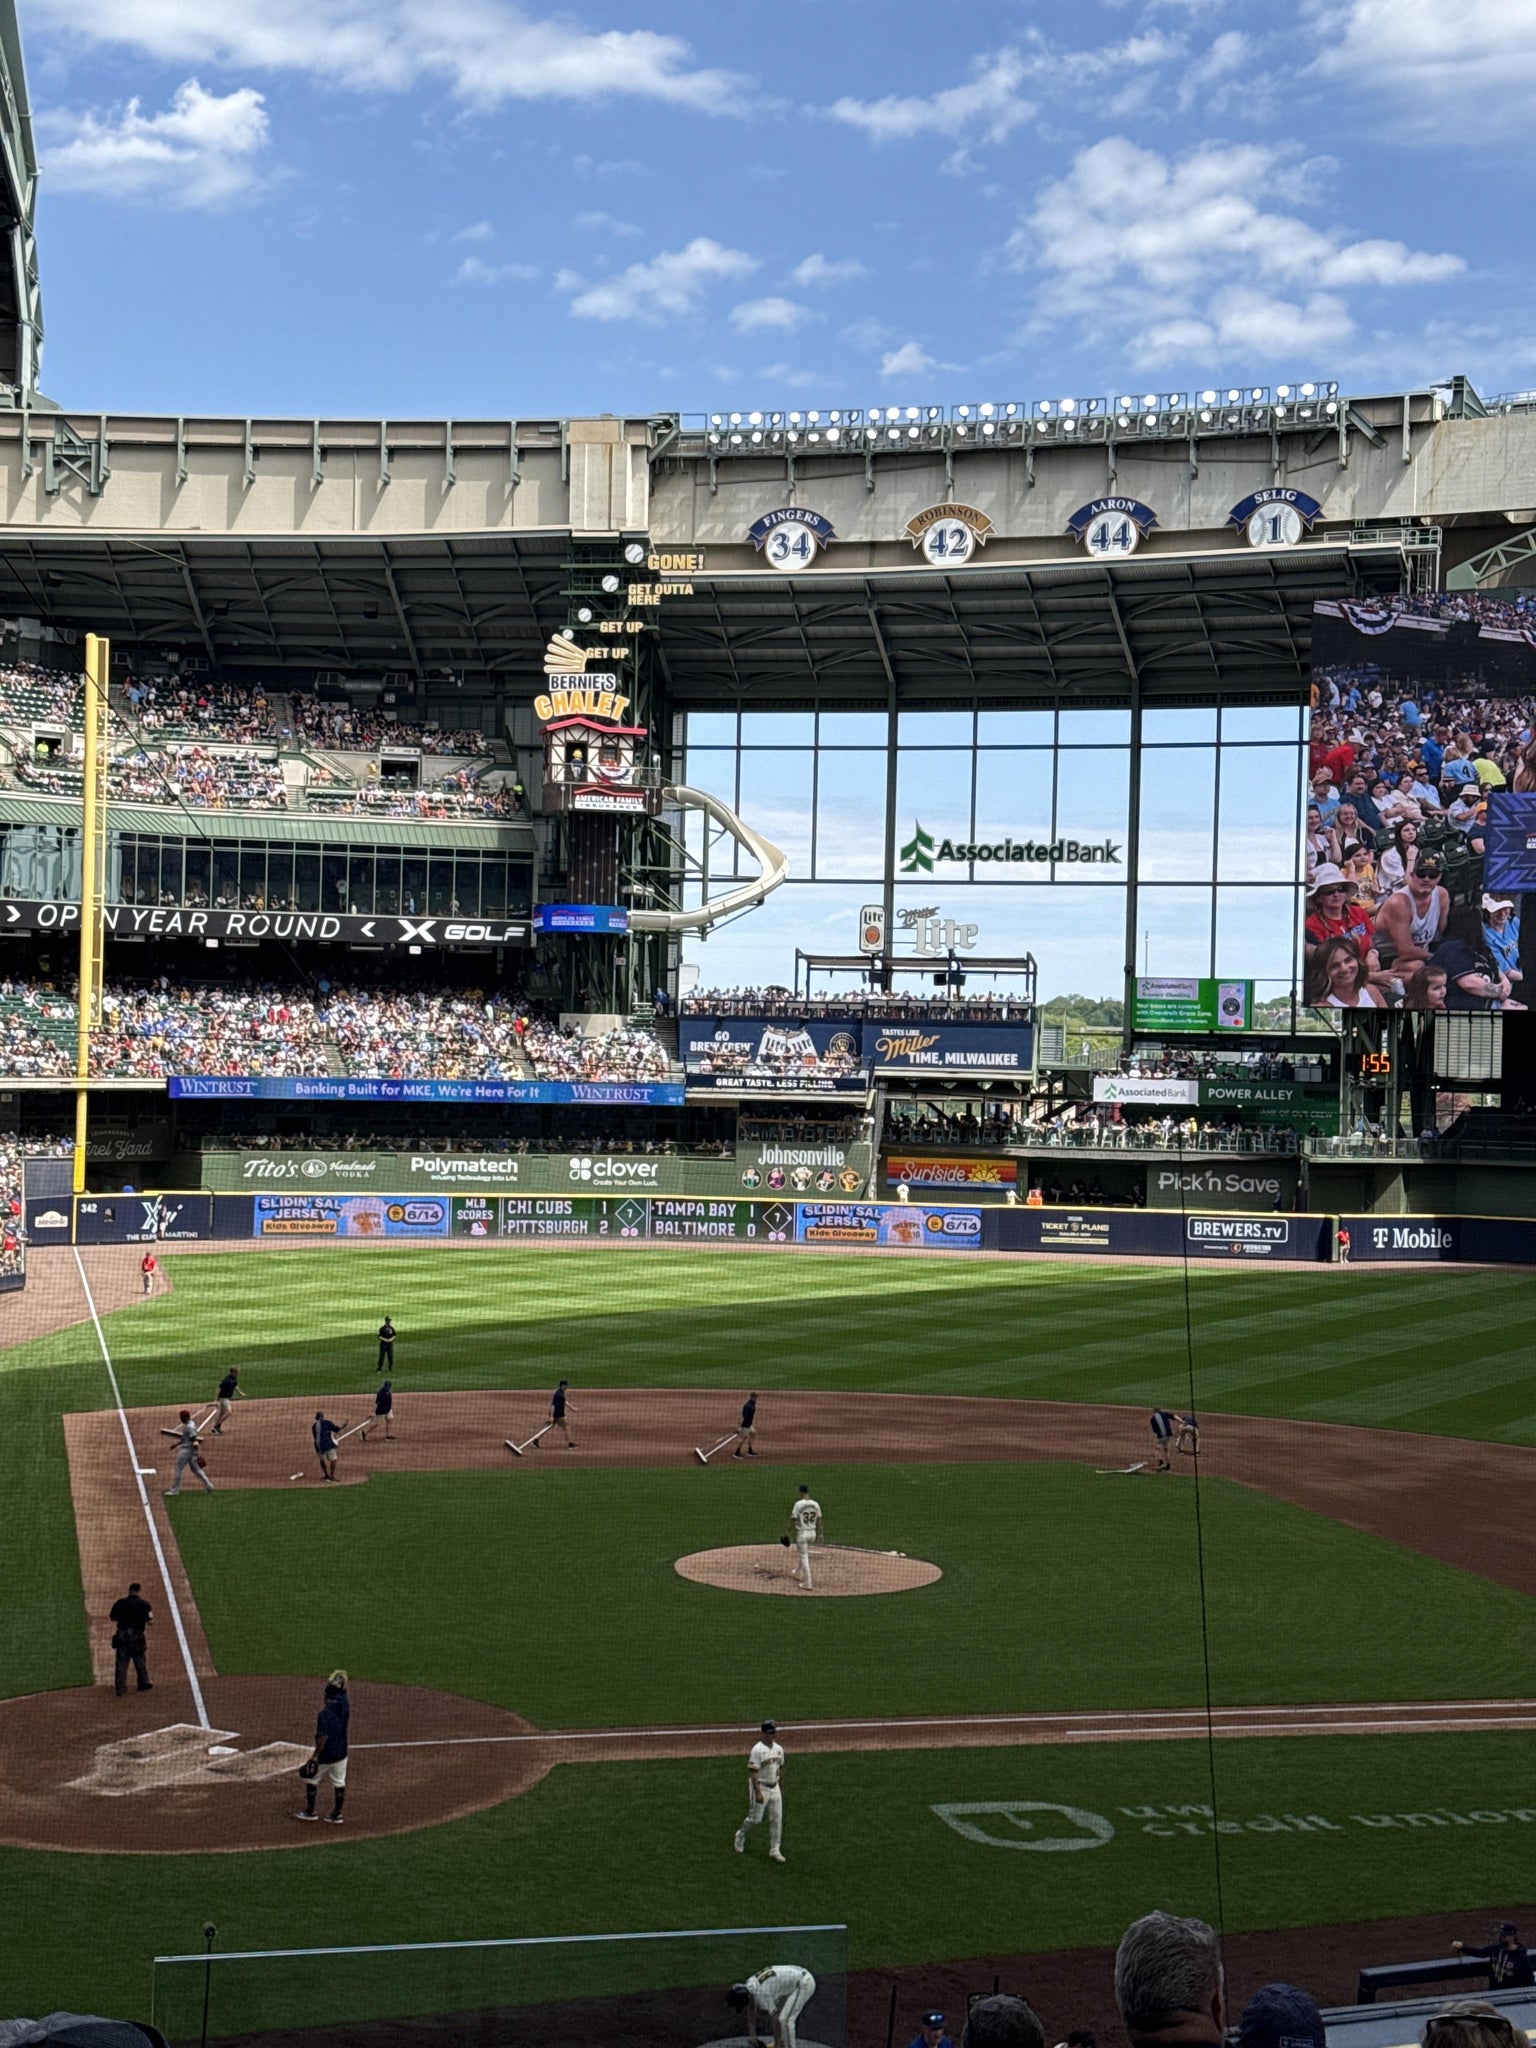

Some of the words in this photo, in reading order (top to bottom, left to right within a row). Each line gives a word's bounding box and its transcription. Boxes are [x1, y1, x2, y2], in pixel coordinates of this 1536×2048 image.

[1253, 489, 1298, 505] SELIG
[1090, 499, 1137, 515] AARON
[762, 509, 821, 528] FINGERS
[916, 505, 982, 527] ROBINSON
[1090, 519, 1133, 552] 44
[1266, 513, 1285, 545] 1
[771, 532, 812, 561] 34
[928, 527, 969, 558] 42
[647, 554, 705, 570] GONE!
[627, 583, 652, 596] GET
[655, 583, 695, 596] OUTTA
[627, 594, 661, 606] HERE
[599, 621, 624, 634] GET
[626, 621, 645, 634] UP
[586, 647, 610, 660] GET
[612, 647, 630, 660] UP
[550, 674, 616, 691] BERNIE'S
[533, 691, 631, 721] CHALET
[575, 794, 615, 804] AMERICAN
[616, 796, 644, 805] FAMILY
[37, 904, 120, 931] OPN
[131, 909, 209, 935] YEAR
[225, 913, 341, 940] ROUND
[443, 923, 527, 942] GOLF
[863, 911, 884, 925] Lite
[911, 917, 980, 958] Lite
[714, 1030, 730, 1042] GO
[881, 1028, 905, 1036] TASTES
[905, 1029, 921, 1037] LIKE
[690, 1040, 720, 1052] BREW
[721, 1042, 751, 1053] CREW
[875, 1034, 941, 1063] Miller
[908, 1051, 943, 1066] TIME,
[944, 1052, 1018, 1066] MILWAUKEE
[1360, 1053, 1390, 1073] 1:55
[295, 1081, 346, 1098] Banking
[348, 1082, 378, 1096] Built
[380, 1082, 400, 1096] for
[402, 1083, 436, 1098] MKE,
[438, 1084, 473, 1097] We're
[475, 1085, 505, 1098] Here
[507, 1086, 527, 1098] For
[529, 1086, 540, 1098] It
[715, 1077, 744, 1087] GREAT
[745, 1078, 775, 1088] TASTE.
[776, 1080, 797, 1089] LESS
[1208, 1087, 1252, 1100] POWER
[1254, 1088, 1294, 1101] ALLEY
[758, 1143, 845, 1167] Johnsonville
[243, 1158, 298, 1179] Tito's
[329, 1159, 377, 1171] Handmade
[411, 1156, 519, 1176] Polymatech
[593, 1157, 659, 1178] clover
[899, 1161, 966, 1183] Surfside
[335, 1171, 370, 1179] VODKA
[456, 1174, 491, 1182] Technology
[592, 1179, 613, 1187] Create
[613, 1179, 628, 1187] Your
[1225, 1174, 1280, 1194] Save
[80, 1203, 98, 1214] 342
[260, 1197, 312, 1210] SLIDIN'
[314, 1198, 341, 1210] SAL
[465, 1199, 487, 1209] MLB
[507, 1200, 534, 1214] CHI
[536, 1201, 573, 1214] CUBS
[601, 1201, 607, 1215] 1
[654, 1201, 706, 1217] TAMPA
[708, 1203, 737, 1218] BAY
[750, 1204, 754, 1218] 1
[274, 1208, 330, 1220] JERSEY
[406, 1210, 440, 1221] 6/14
[456, 1209, 494, 1220] SCORES
[627, 1208, 633, 1219] 7
[774, 1212, 780, 1223] 7
[804, 1205, 853, 1217] SLIDIN'
[855, 1207, 882, 1219] SAL
[265, 1221, 287, 1231] Kids
[289, 1222, 336, 1232] Giveaway
[507, 1219, 588, 1235] PITTSBURGH
[600, 1221, 608, 1235] 2
[817, 1215, 870, 1228] JERSEY
[945, 1220, 978, 1231] 6/14
[1041, 1222, 1069, 1230] TICKET
[1080, 1223, 1110, 1232] PLANS
[126, 1233, 140, 1241] THE
[165, 1231, 199, 1239] MARTINI
[655, 1220, 736, 1237] BALTIMORE
[747, 1223, 756, 1238] 0
[809, 1230, 830, 1238] Kids
[832, 1231, 876, 1239] Giveaway
[1391, 1227, 1453, 1249] Mobile
[803, 1511, 816, 1524] 32
[1117, 1803, 1215, 1820] uw
[1141, 1813, 1344, 1837] credit
